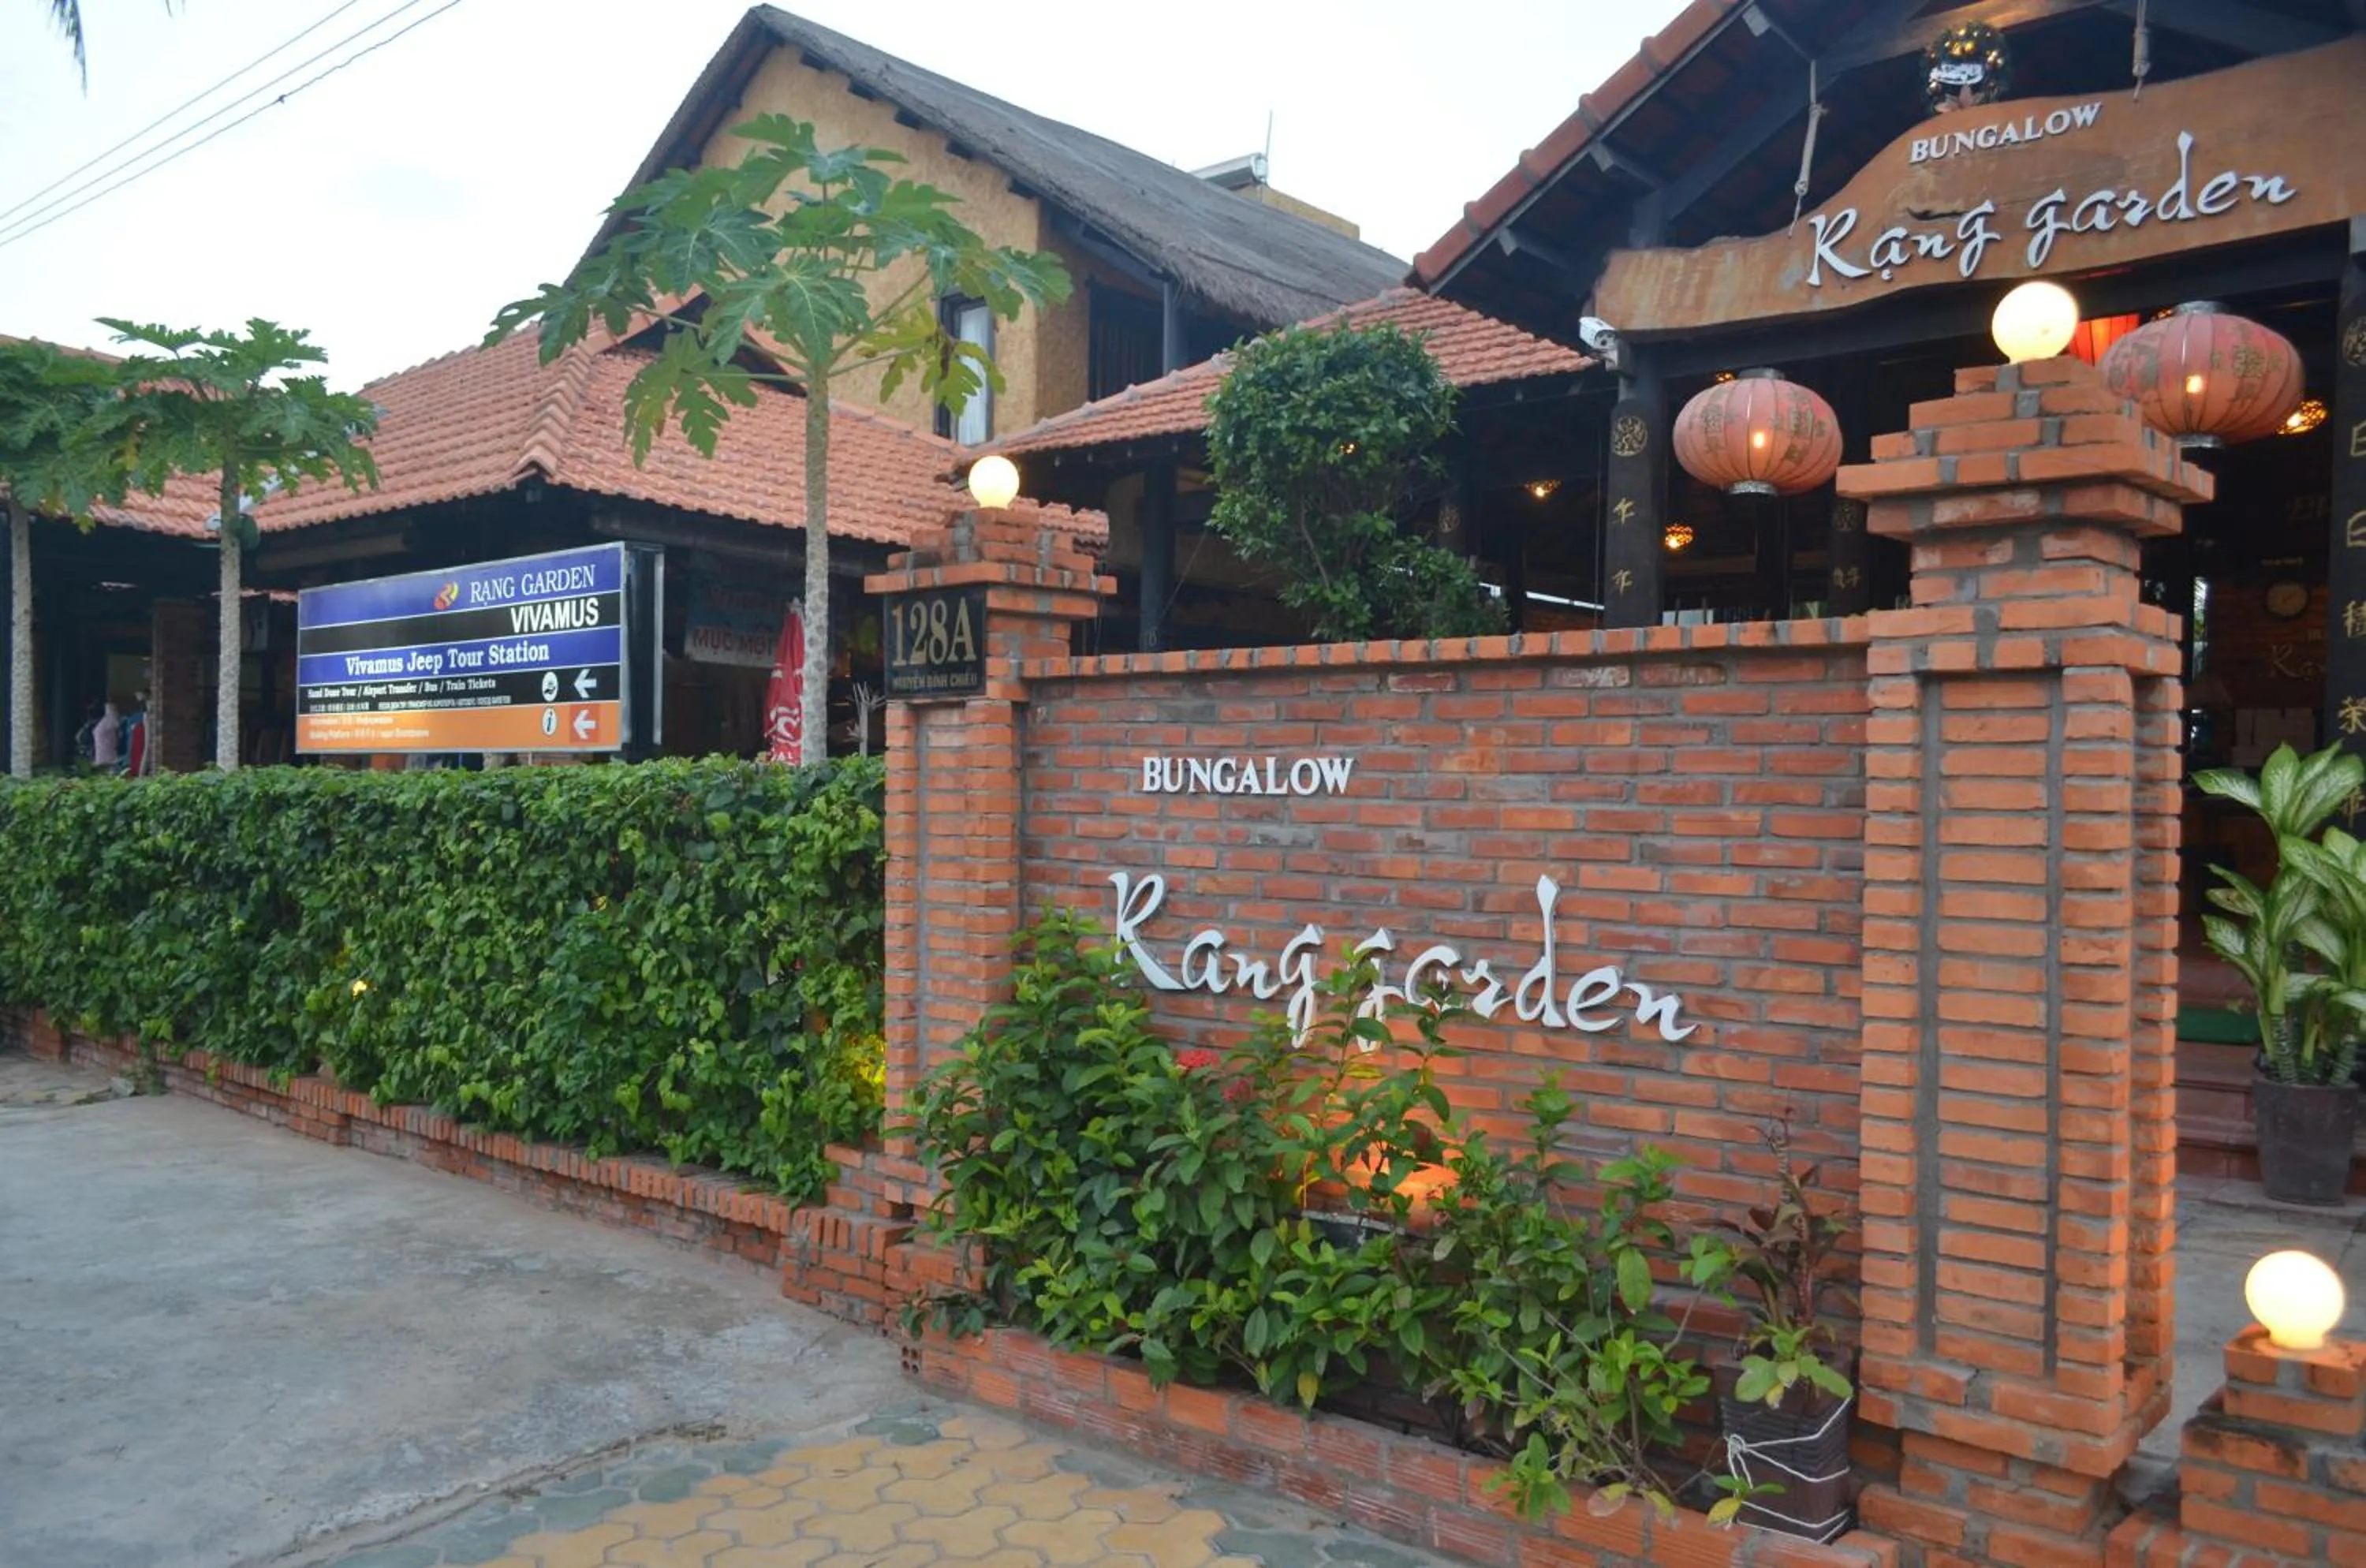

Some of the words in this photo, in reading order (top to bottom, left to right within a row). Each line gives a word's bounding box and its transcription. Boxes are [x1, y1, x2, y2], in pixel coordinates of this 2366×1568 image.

[1909, 101, 2103, 164] BUNGALOW
[2025, 131, 2298, 268] garden
[521, 564, 595, 595] GARDEN
[510, 596, 599, 633] VIVAMUS
[891, 596, 978, 666] 128A
[345, 656, 403, 677] Vivamus
[406, 651, 442, 674] Jeep
[447, 648, 483, 669] Tour
[488, 640, 550, 665] Station
[363, 685, 387, 698] Airport
[388, 683, 417, 695] Transfer
[424, 681, 438, 693] Bus
[446, 680, 467, 692] Train
[468, 678, 497, 689] Tickets
[1141, 756, 1356, 795] BUNGALOW
[1108, 871, 1328, 1049] Rang
[1347, 873, 1701, 1054] garden
